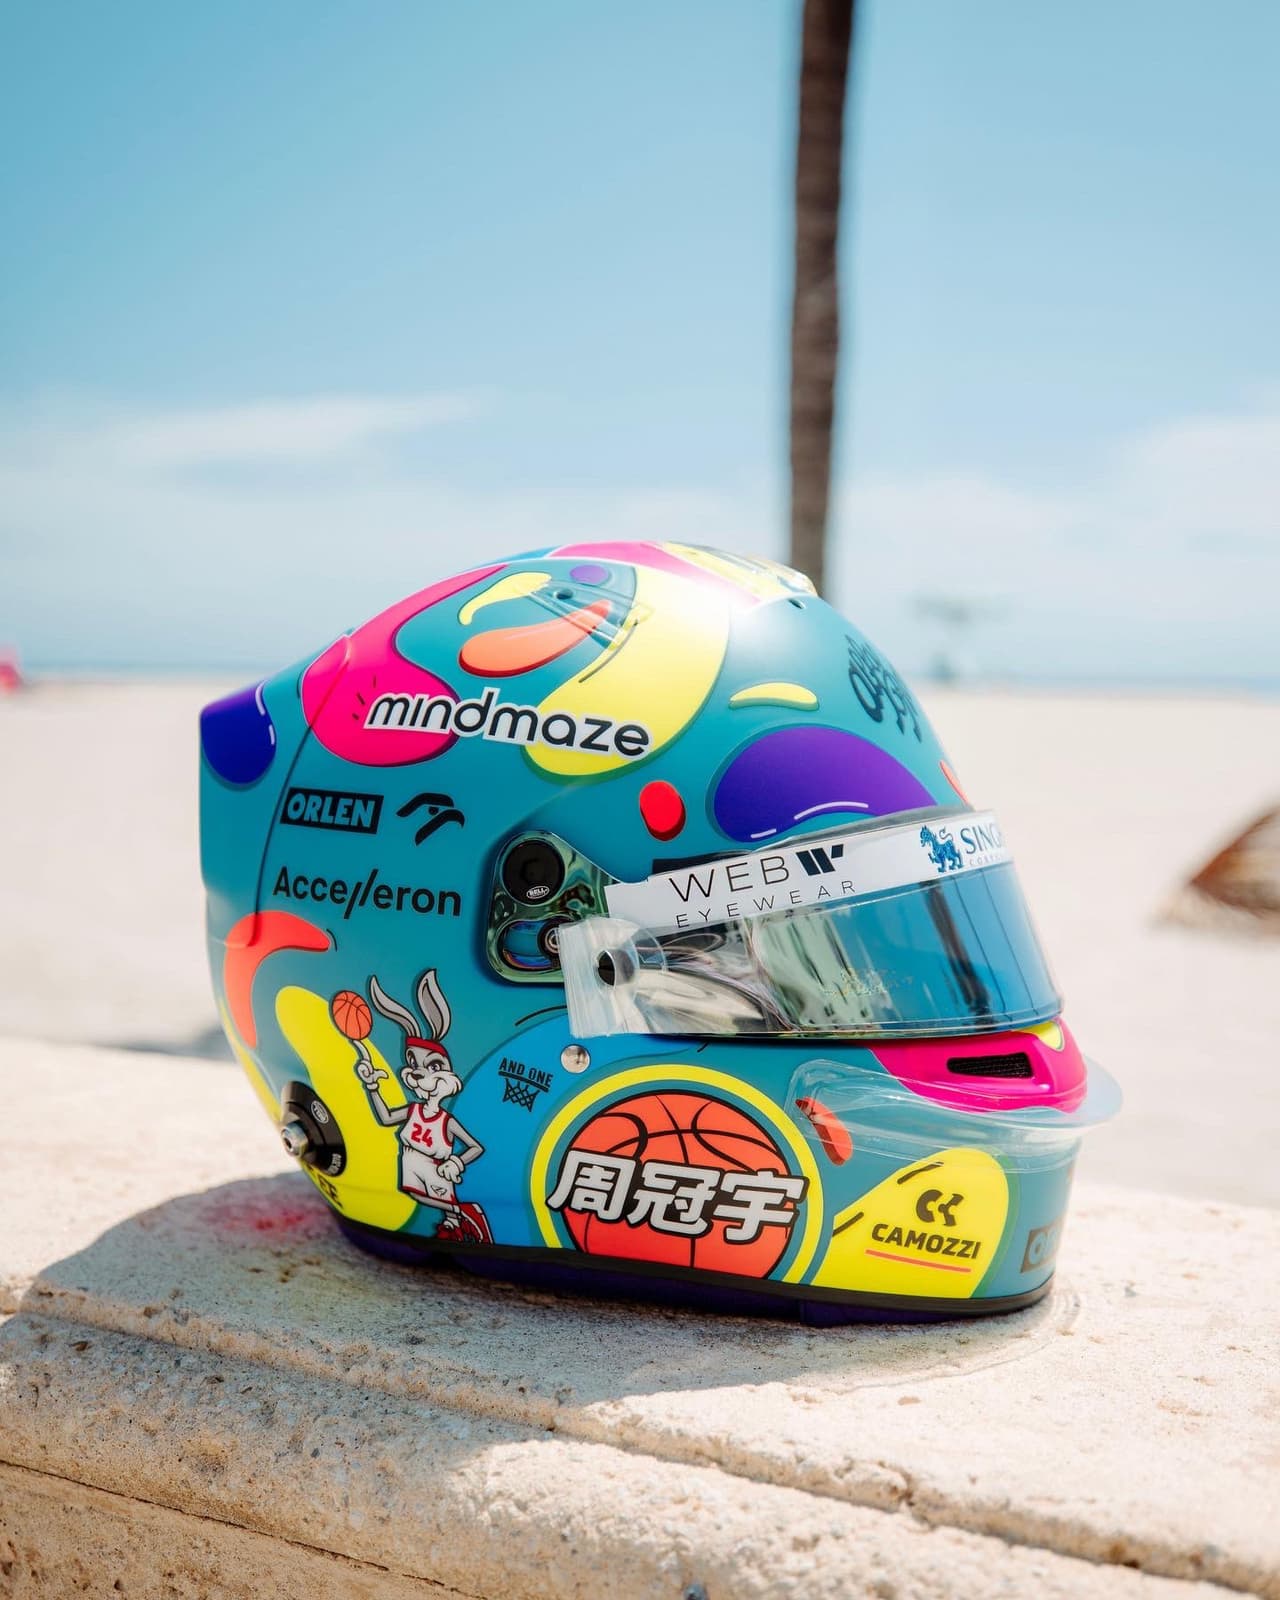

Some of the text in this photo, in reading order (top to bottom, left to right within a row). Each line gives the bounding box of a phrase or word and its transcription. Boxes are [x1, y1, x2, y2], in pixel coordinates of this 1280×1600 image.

[369, 691, 649, 756] mindmaze
[287, 793, 375, 828] ORLEN
[669, 855, 790, 902] WEB
[676, 880, 855, 928] EYEWEAR
[499, 1057, 554, 1087] AND ONE
[410, 1122, 433, 1148] 24
[547, 1150, 805, 1241] 周冠宇
[871, 1223, 981, 1259] CAMOZZI
